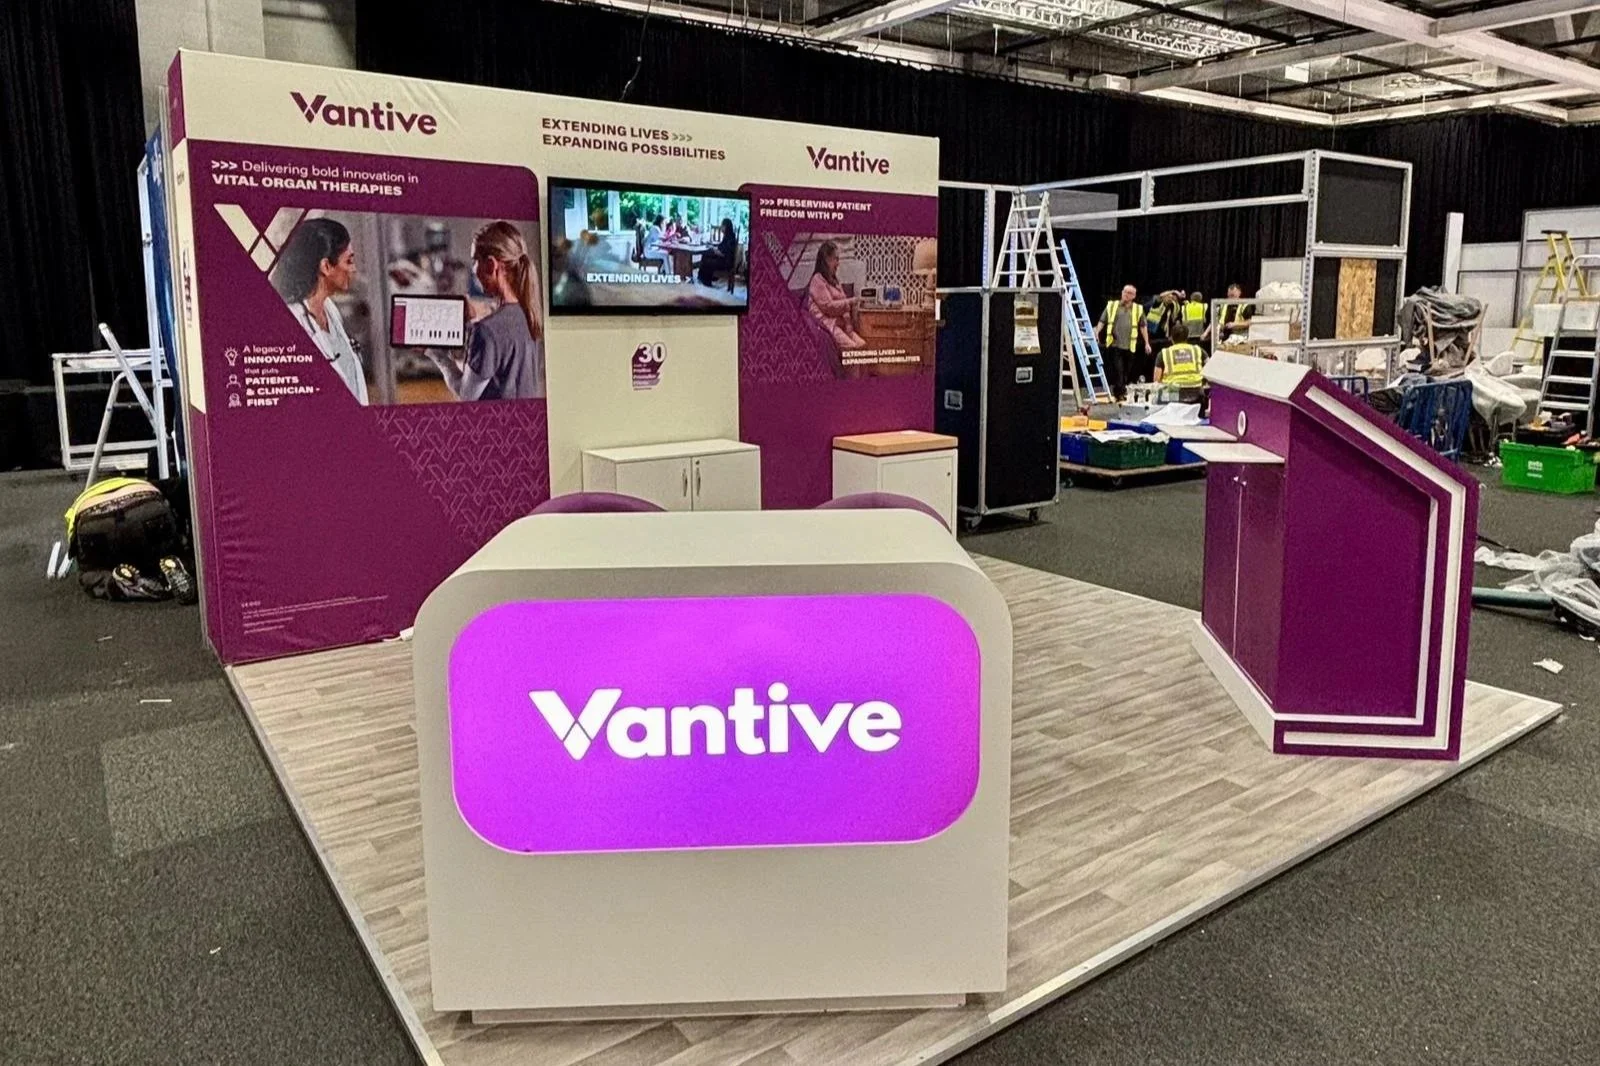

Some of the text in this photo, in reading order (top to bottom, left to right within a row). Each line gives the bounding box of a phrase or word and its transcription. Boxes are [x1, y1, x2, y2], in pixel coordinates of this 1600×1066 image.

[290, 92, 437, 135] Vantive
[542, 118, 669, 141] EXTENDING LIVES
[542, 134, 726, 160] EXPANDING POSSIBILITIES
[806, 146, 890, 174] Vantive
[242, 160, 419, 184] Delivering bold innovation in
[212, 174, 402, 196] VITAL ORGAN THERAPIES
[776, 198, 872, 212] PRESERVING PATIENT
[760, 208, 844, 220] FREEDOM WITH PD
[586, 272, 681, 284] EXTENDING LIVES
[243, 344, 296, 354] A legacy of
[638, 342, 666, 363] 30
[244, 355, 312, 364] INNOVATION
[245, 376, 299, 385] PATIENTS
[246, 388, 255, 396] &
[256, 386, 314, 396] CLINICIAN
[246, 398, 280, 406] FIRST
[528, 682, 902, 760] Vantive
